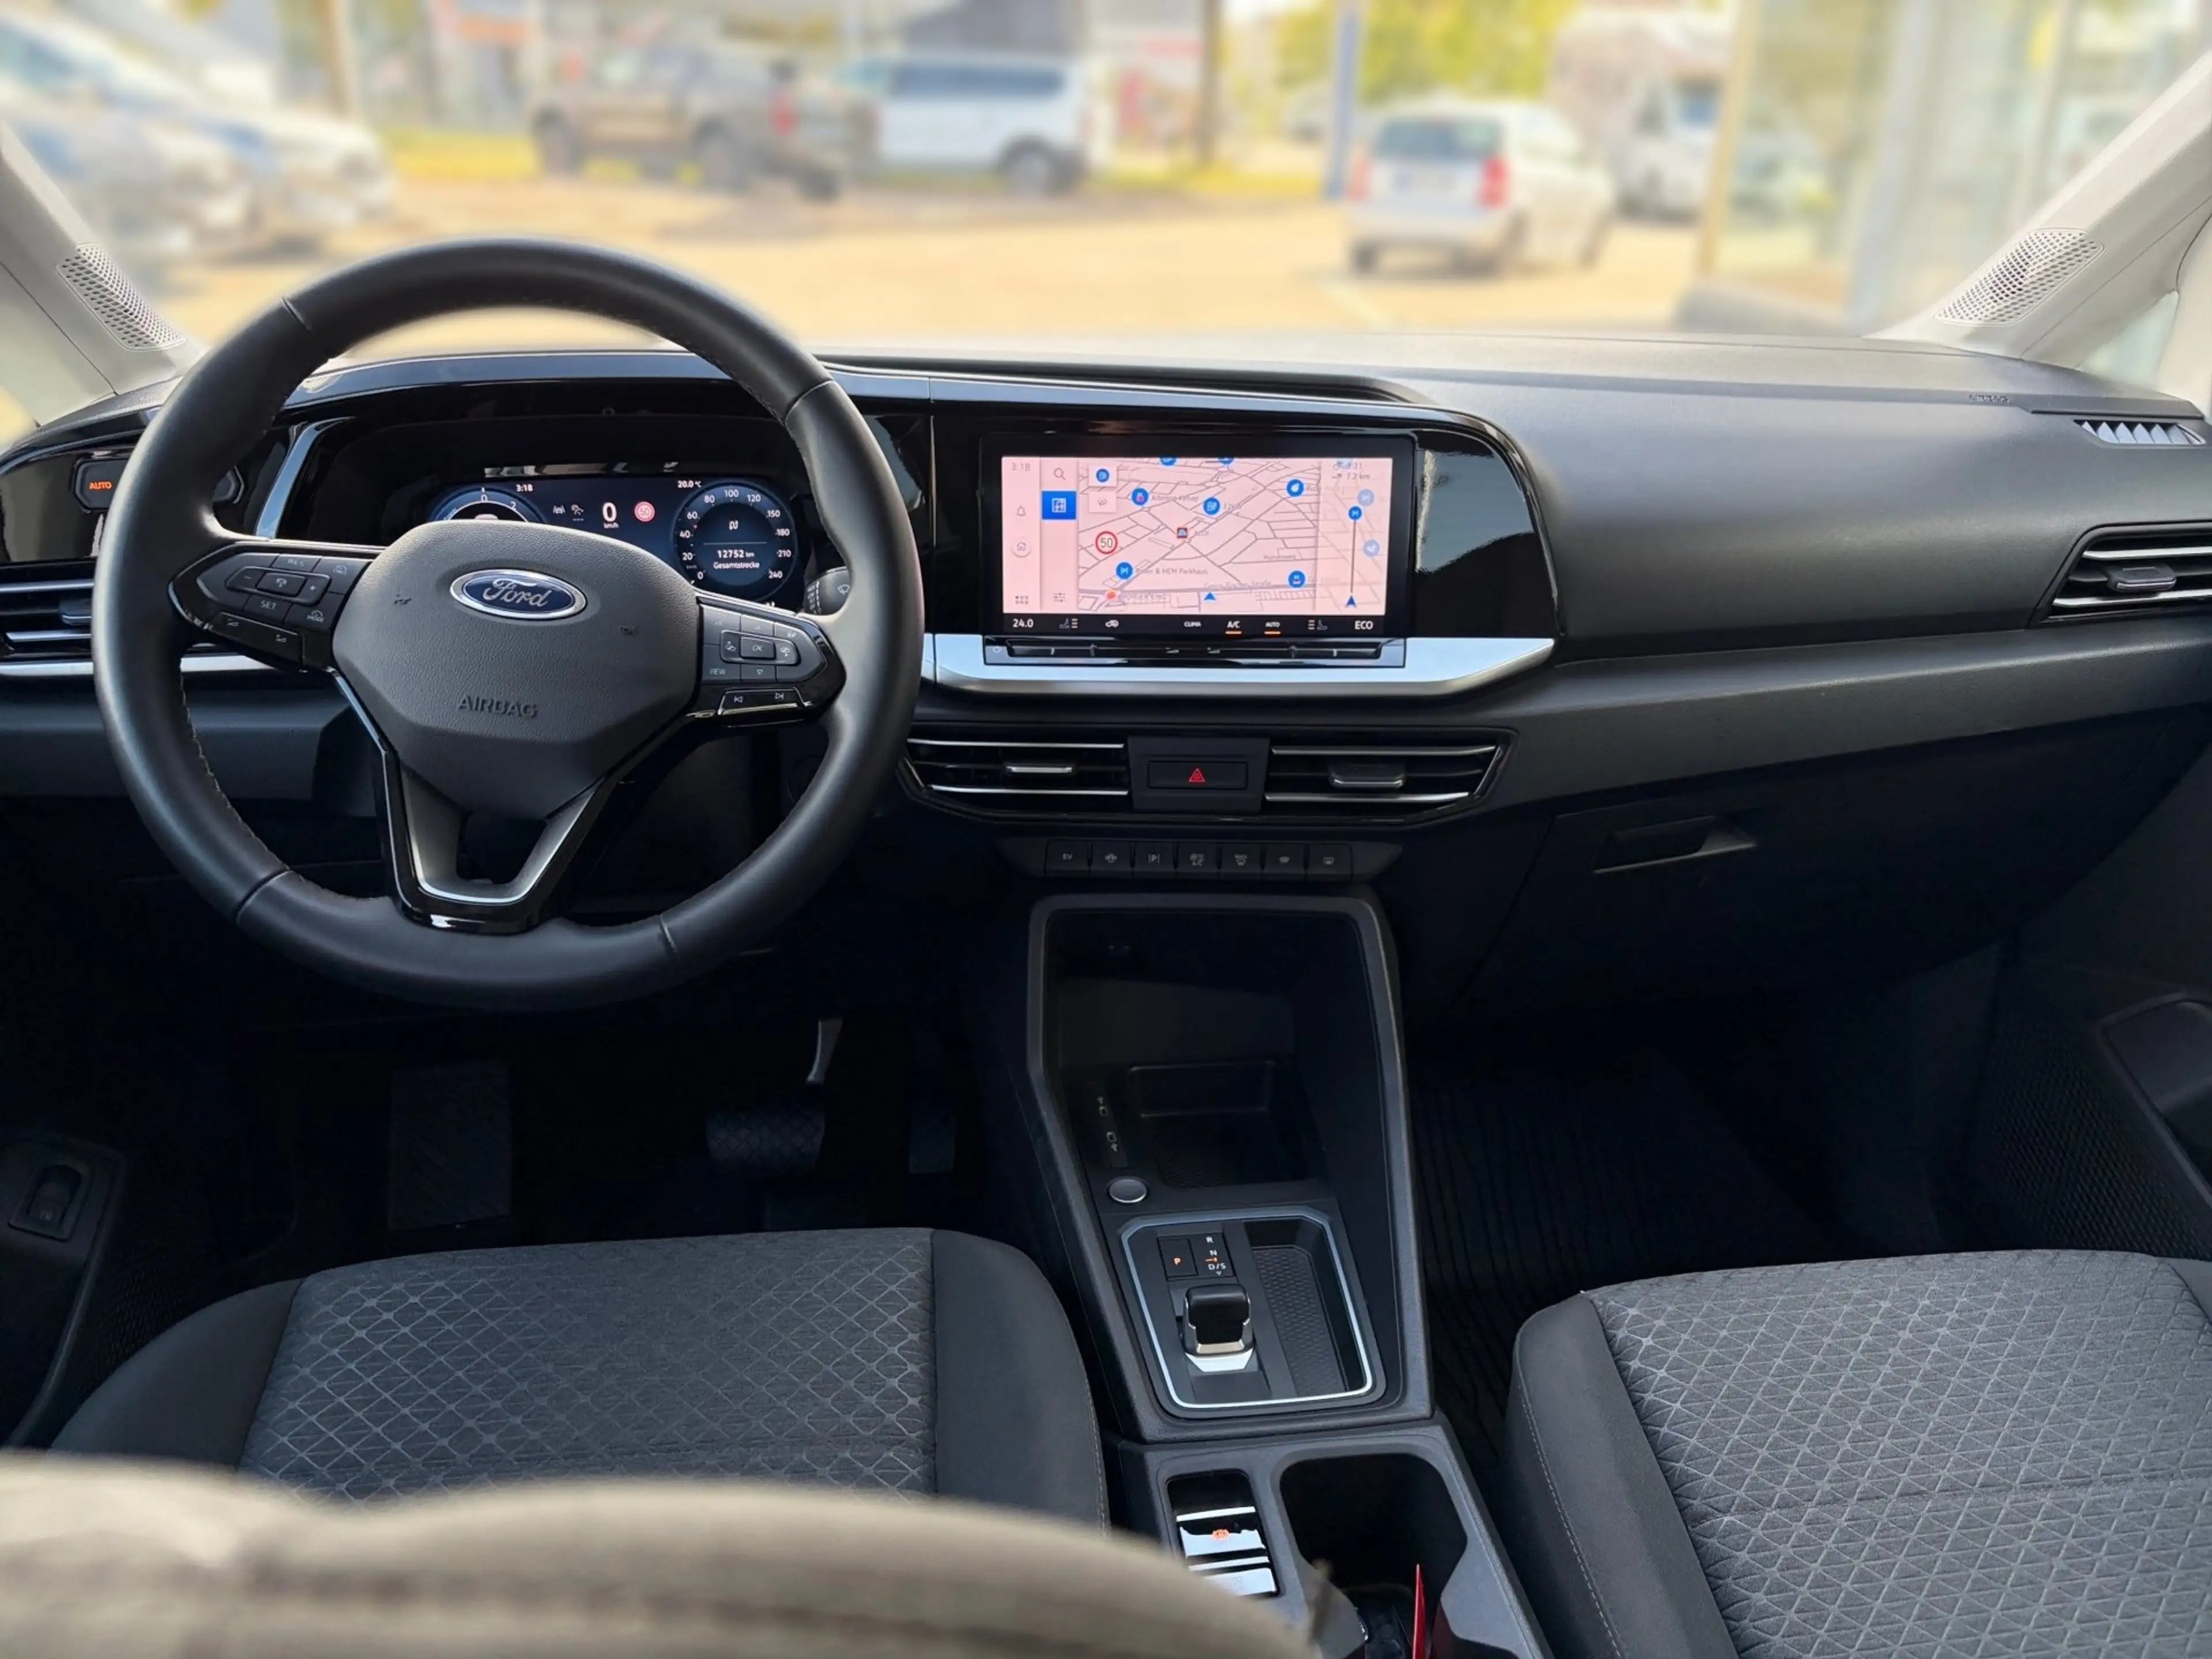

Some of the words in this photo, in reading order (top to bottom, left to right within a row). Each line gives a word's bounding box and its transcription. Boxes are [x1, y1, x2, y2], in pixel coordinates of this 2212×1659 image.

[89, 482, 112, 490] AUTO
[725, 490, 739, 498] 100
[747, 494, 761, 502] 120
[704, 495, 715, 503] 80
[510, 501, 517, 510] 2
[602, 502, 617, 522] 0
[687, 511, 698, 520] 60
[767, 510, 781, 518] 150
[777, 528, 790, 536] 180
[1100, 537, 1113, 548] 50
[682, 552, 693, 560] 20
[717, 550, 744, 558] 12752
[777, 550, 791, 558] 210
[698, 571, 704, 579] 0
[768, 571, 783, 579] 240
[482, 578, 552, 607] Ford
[260, 600, 277, 609] SET
[1012, 618, 1034, 628] 24.0
[1227, 620, 1240, 628] A/C
[1354, 620, 1373, 630] ECO
[459, 695, 539, 719] AIRBAG
[1173, 1257, 1181, 1266] P
